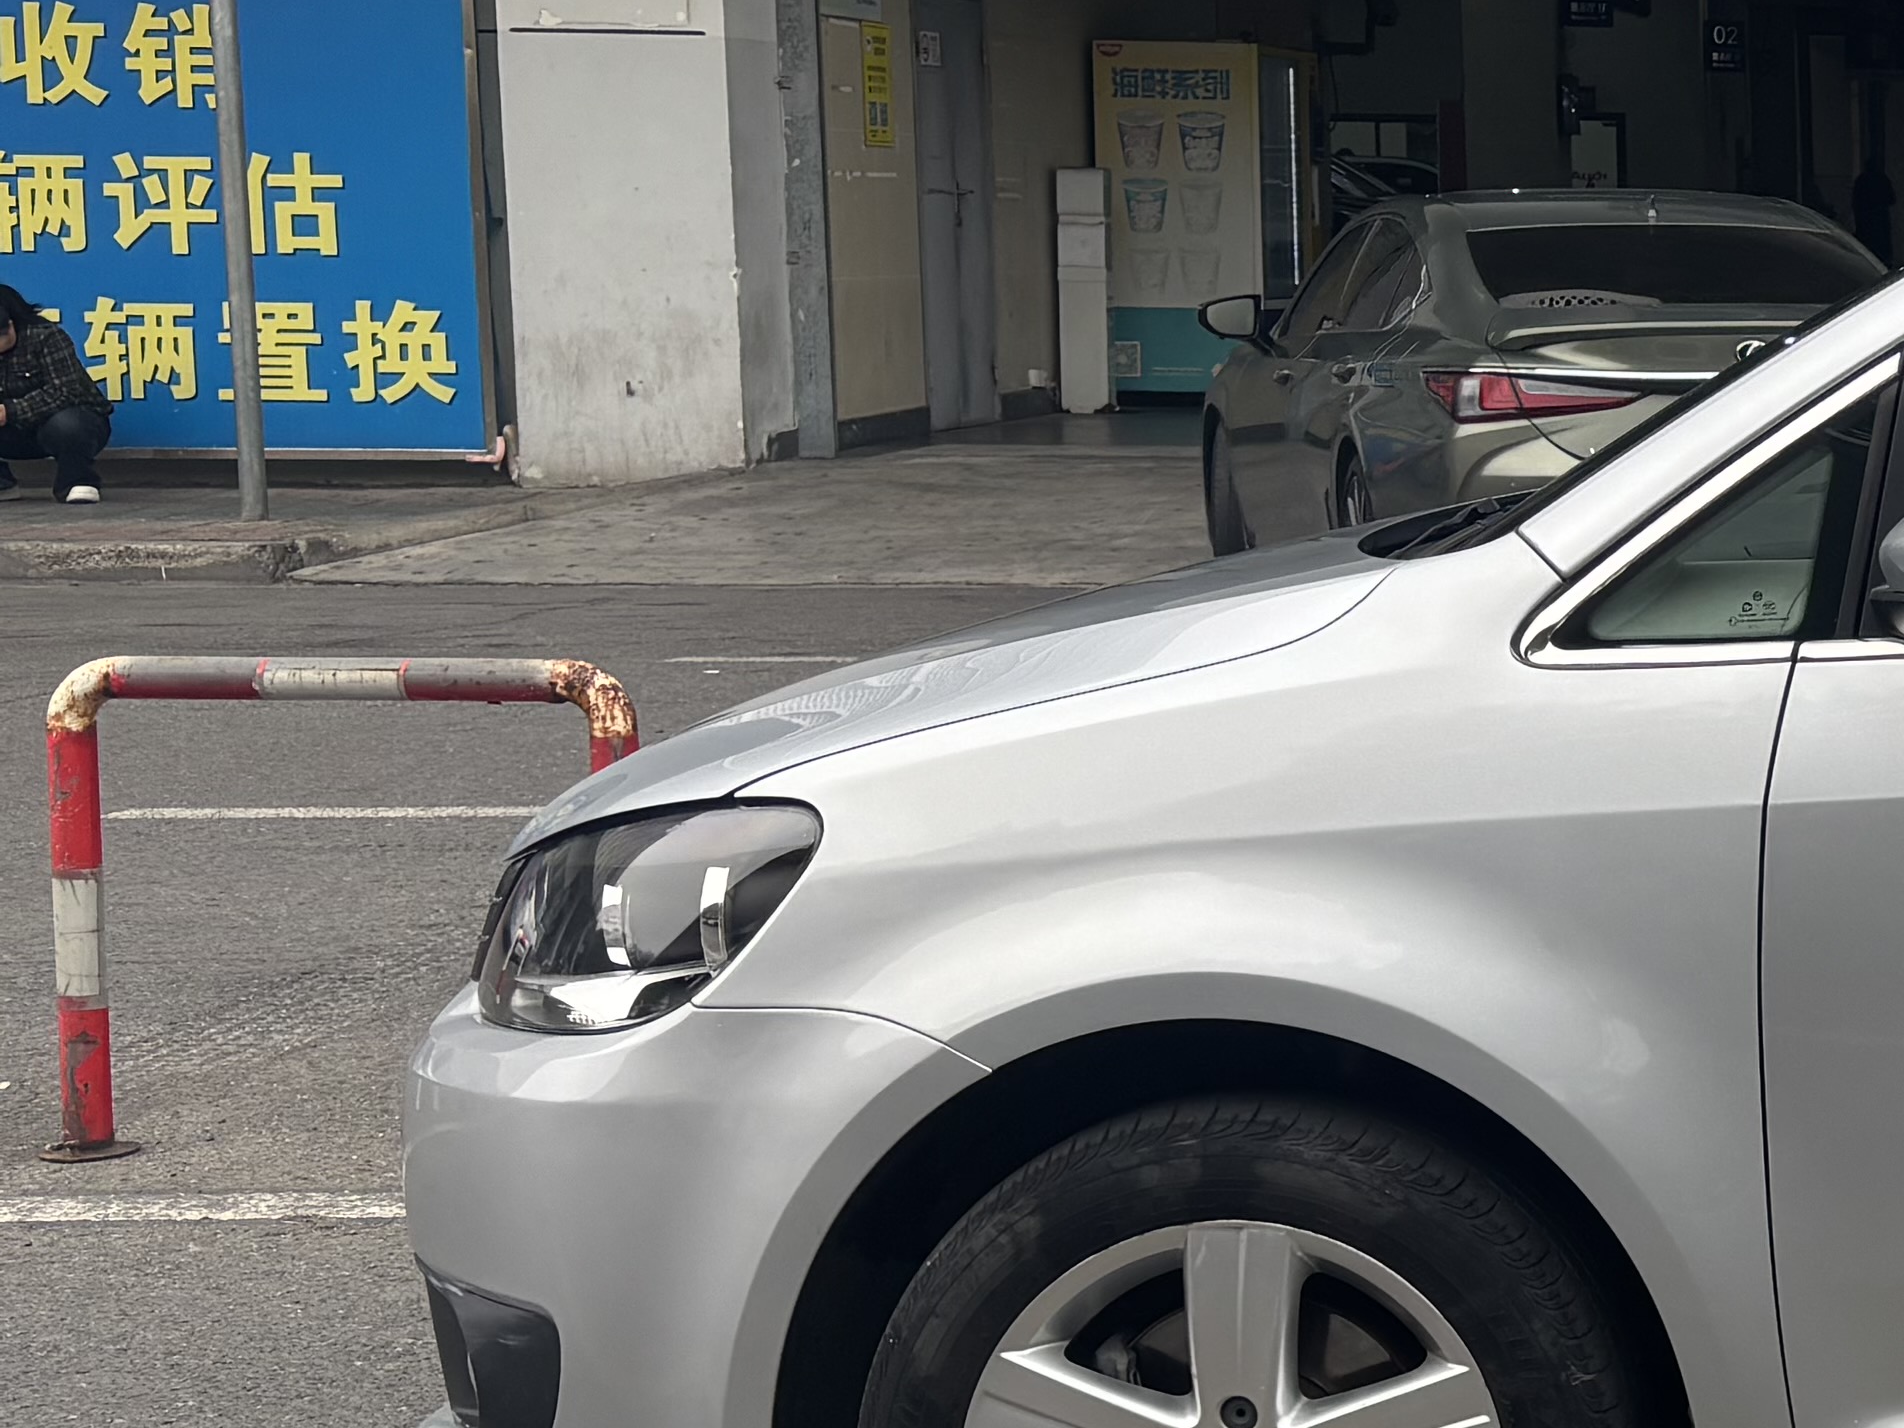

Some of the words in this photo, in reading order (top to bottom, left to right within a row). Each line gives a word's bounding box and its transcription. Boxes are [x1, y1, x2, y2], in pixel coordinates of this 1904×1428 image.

[0, 1, 217, 110] 收销
[1112, 66, 1230, 101] 海鲜系列
[1713, 25, 1738, 45] 02
[0, 150, 344, 257] 辆评估
[38, 296, 457, 405] 辆置换
